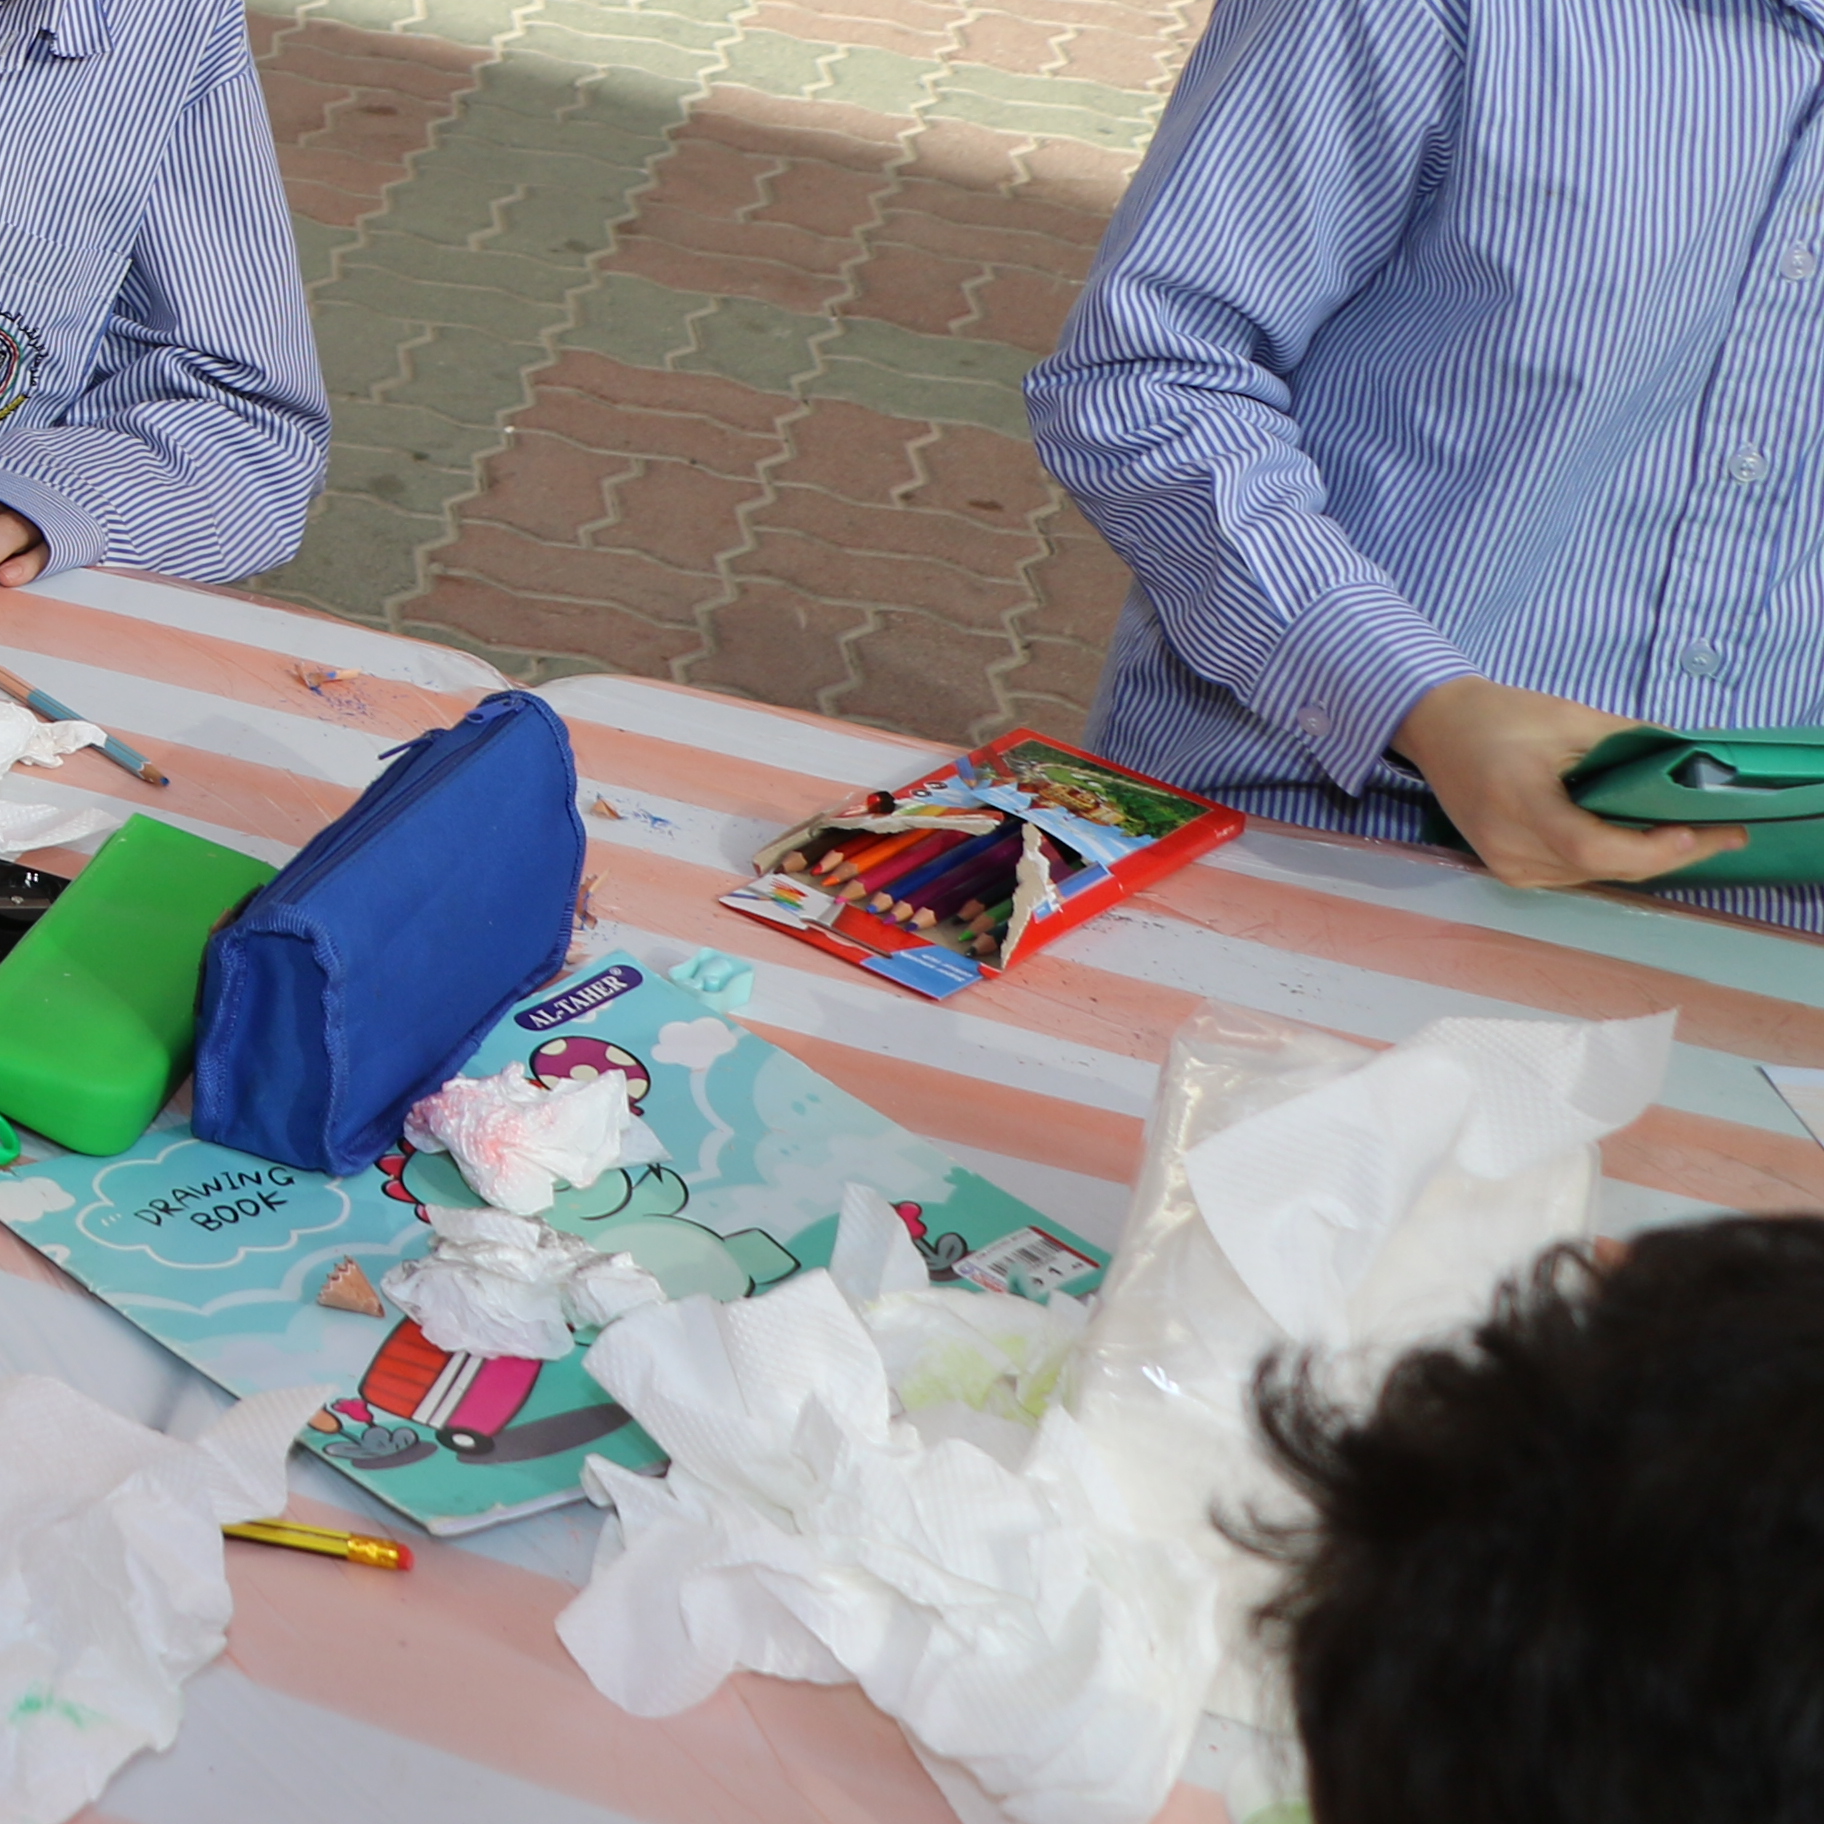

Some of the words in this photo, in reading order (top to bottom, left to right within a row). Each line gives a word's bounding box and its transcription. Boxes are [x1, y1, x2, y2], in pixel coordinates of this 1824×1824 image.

[529, 975, 628, 1028] AL-TAHER
[134, 1166, 295, 1227] DRAWING
[190, 1191, 288, 1232] BOOK
